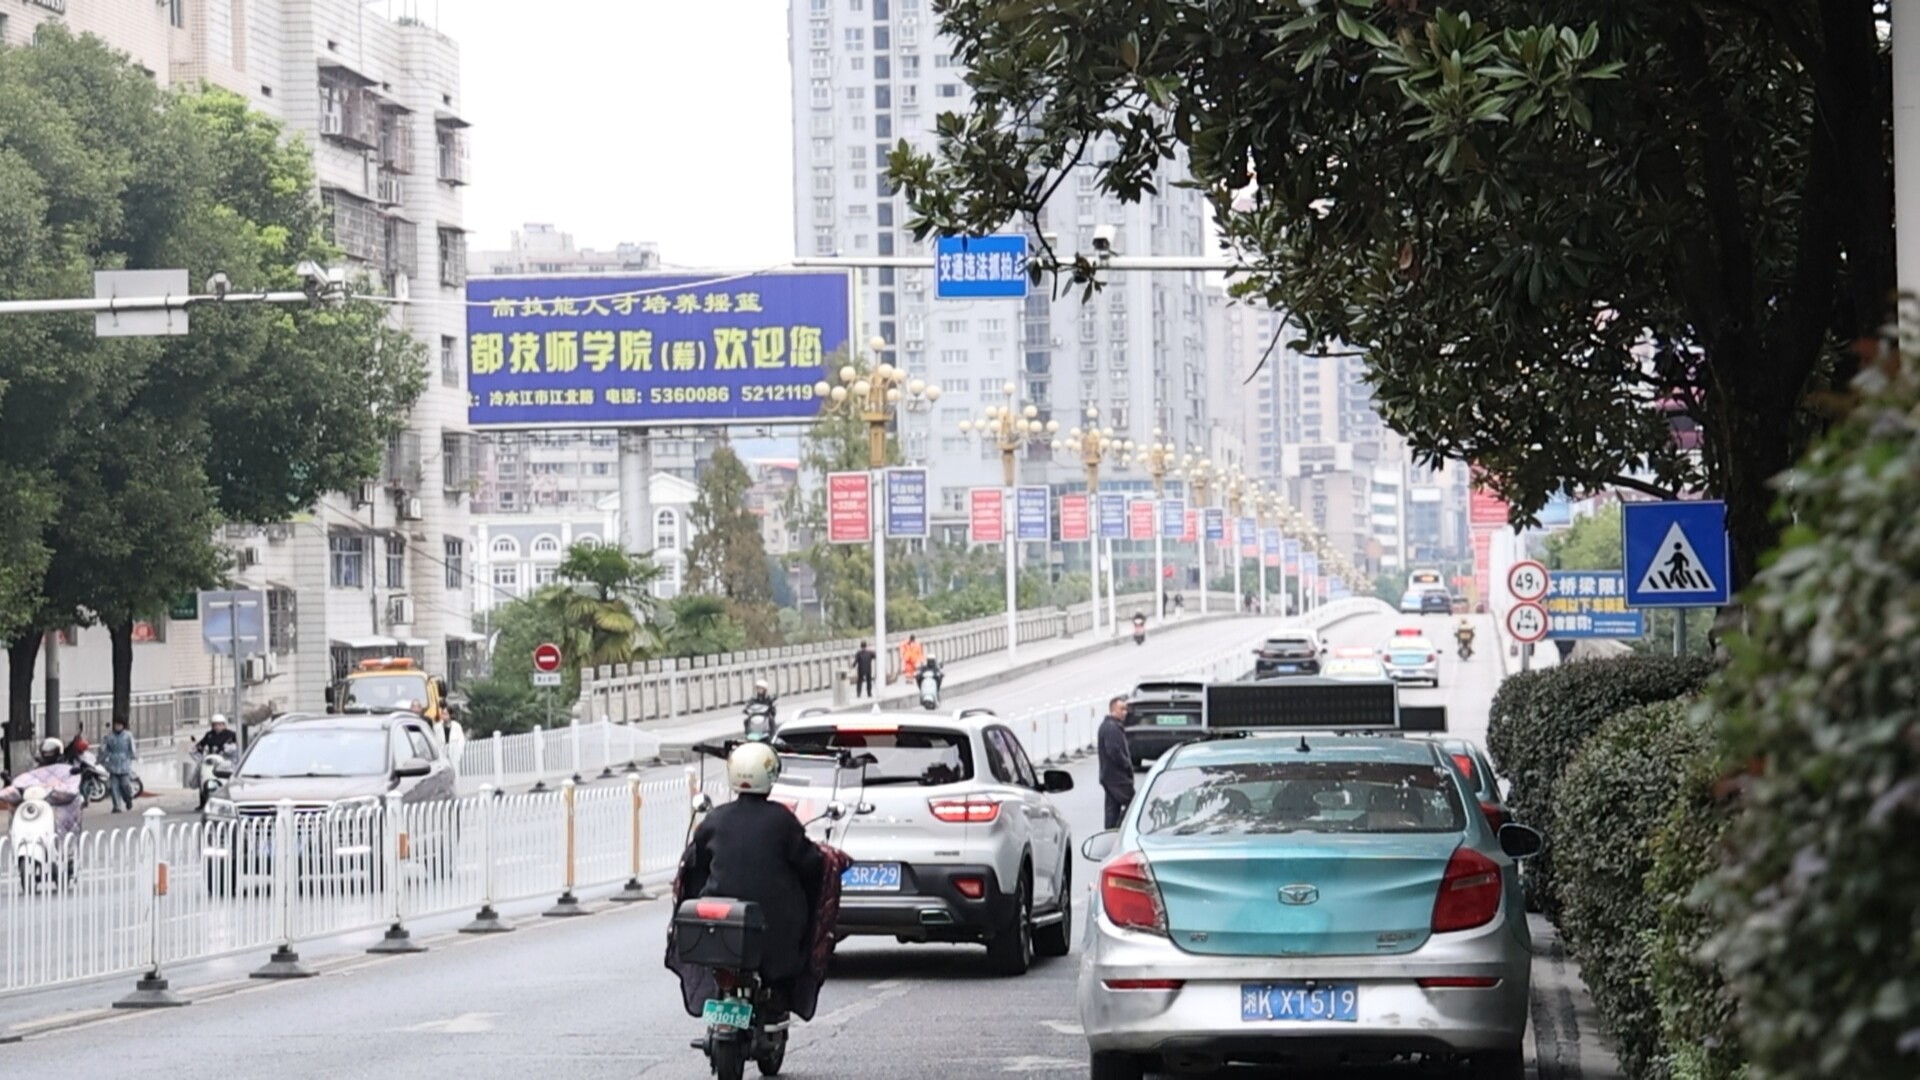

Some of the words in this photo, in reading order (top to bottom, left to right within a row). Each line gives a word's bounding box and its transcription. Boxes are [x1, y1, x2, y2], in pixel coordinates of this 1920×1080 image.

[489, 388, 595, 407] 冷水江市江北路
[650, 386, 730, 404] 5360086
[741, 384, 813, 402] 5212119
[851, 865, 898, 884] 3RZ29
